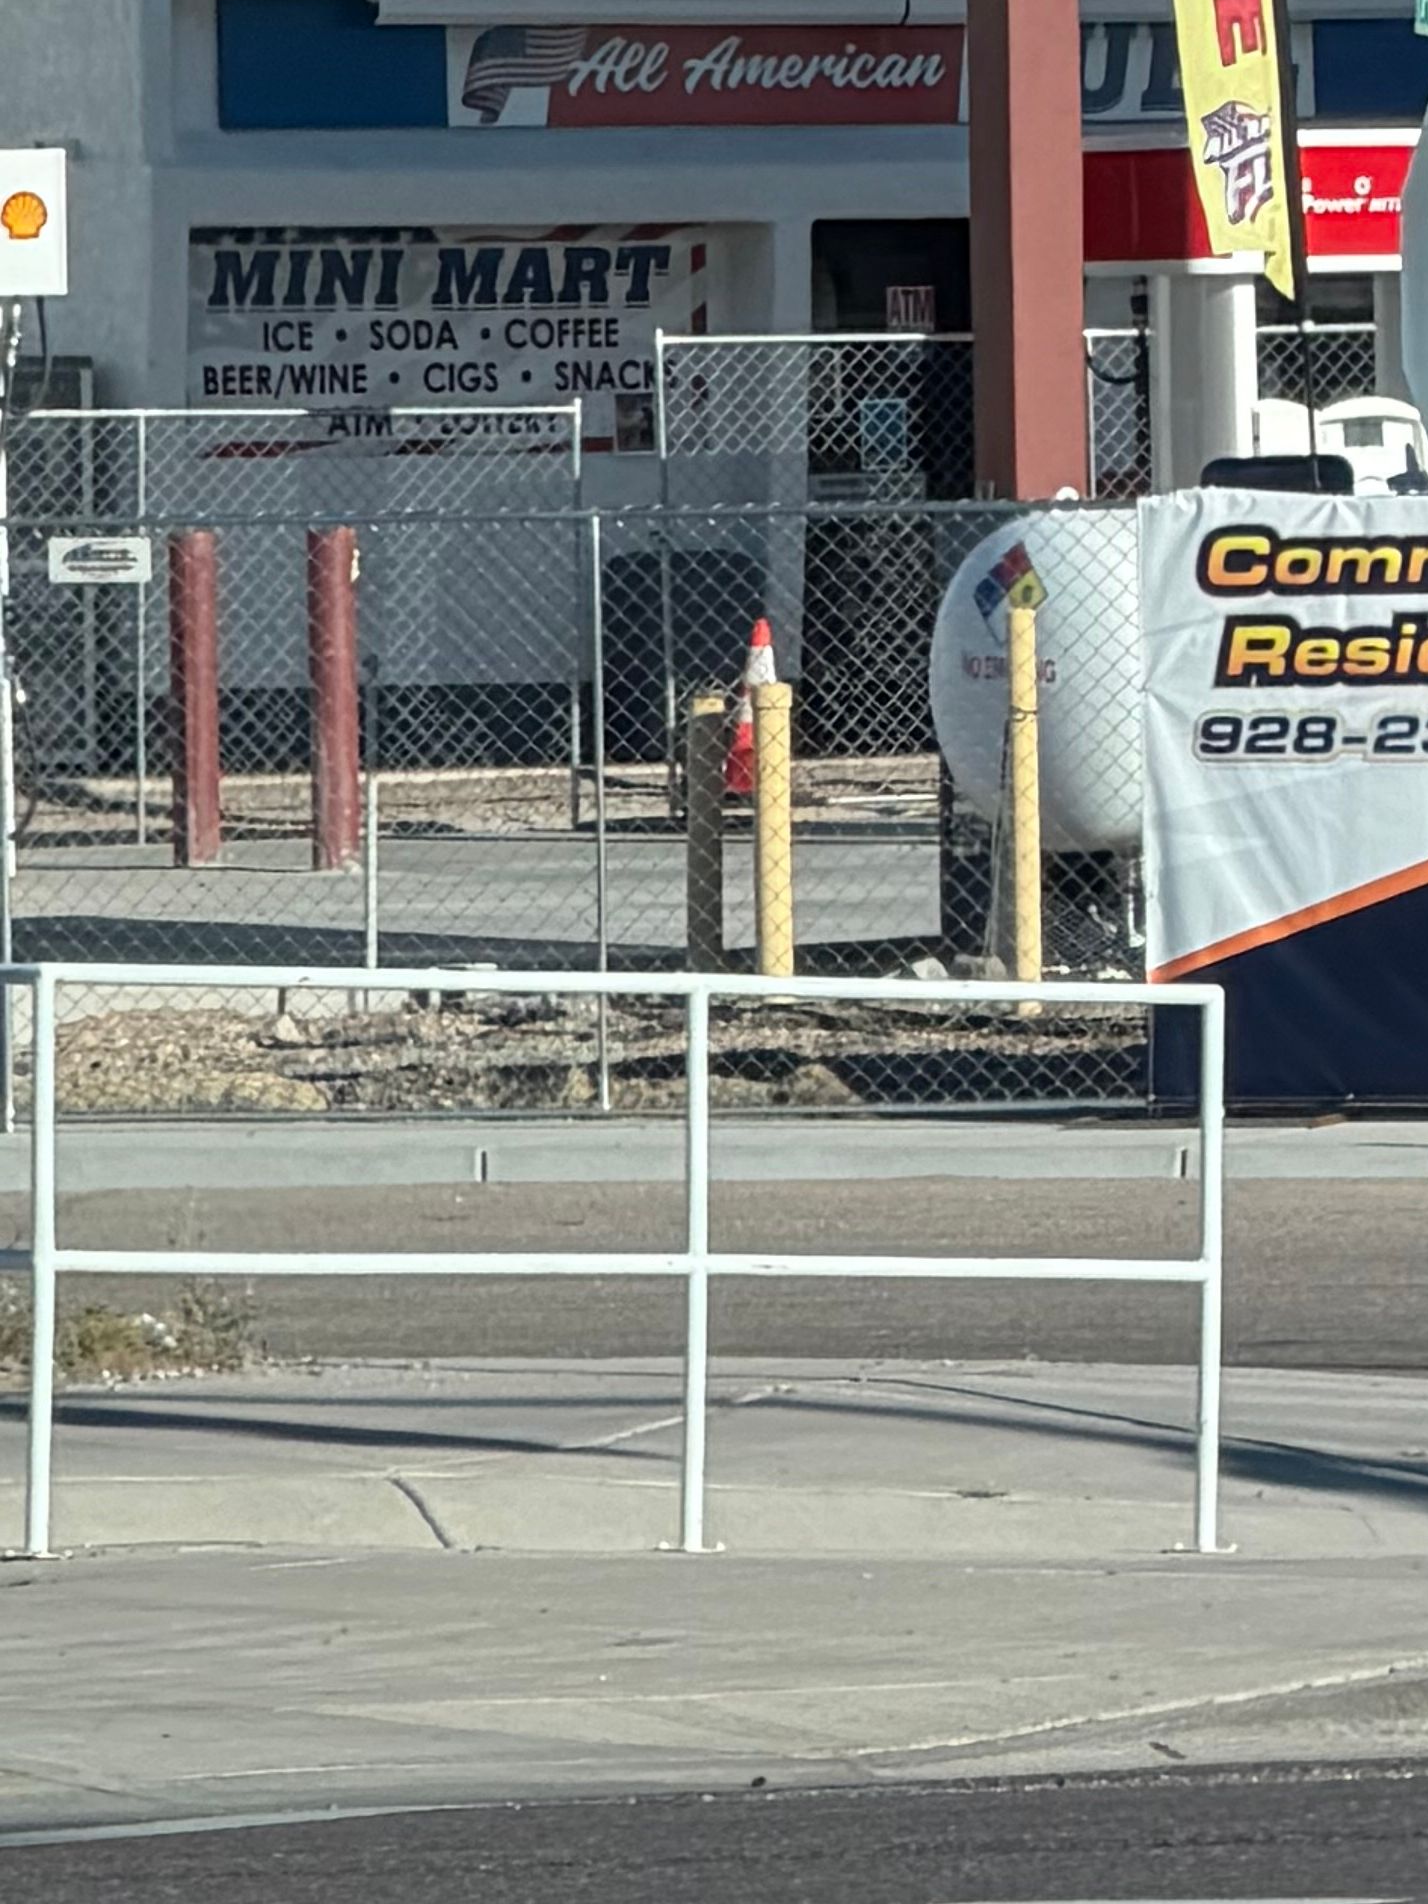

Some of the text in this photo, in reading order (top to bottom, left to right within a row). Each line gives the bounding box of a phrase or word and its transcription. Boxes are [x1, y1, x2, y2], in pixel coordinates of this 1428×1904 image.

[567, 35, 947, 96] All American
[206, 245, 672, 312] MINI MART
[262, 318, 620, 352] ICE SODA COFFEE
[203, 362, 368, 398] BEER/WINE
[423, 362, 499, 393] CIGS
